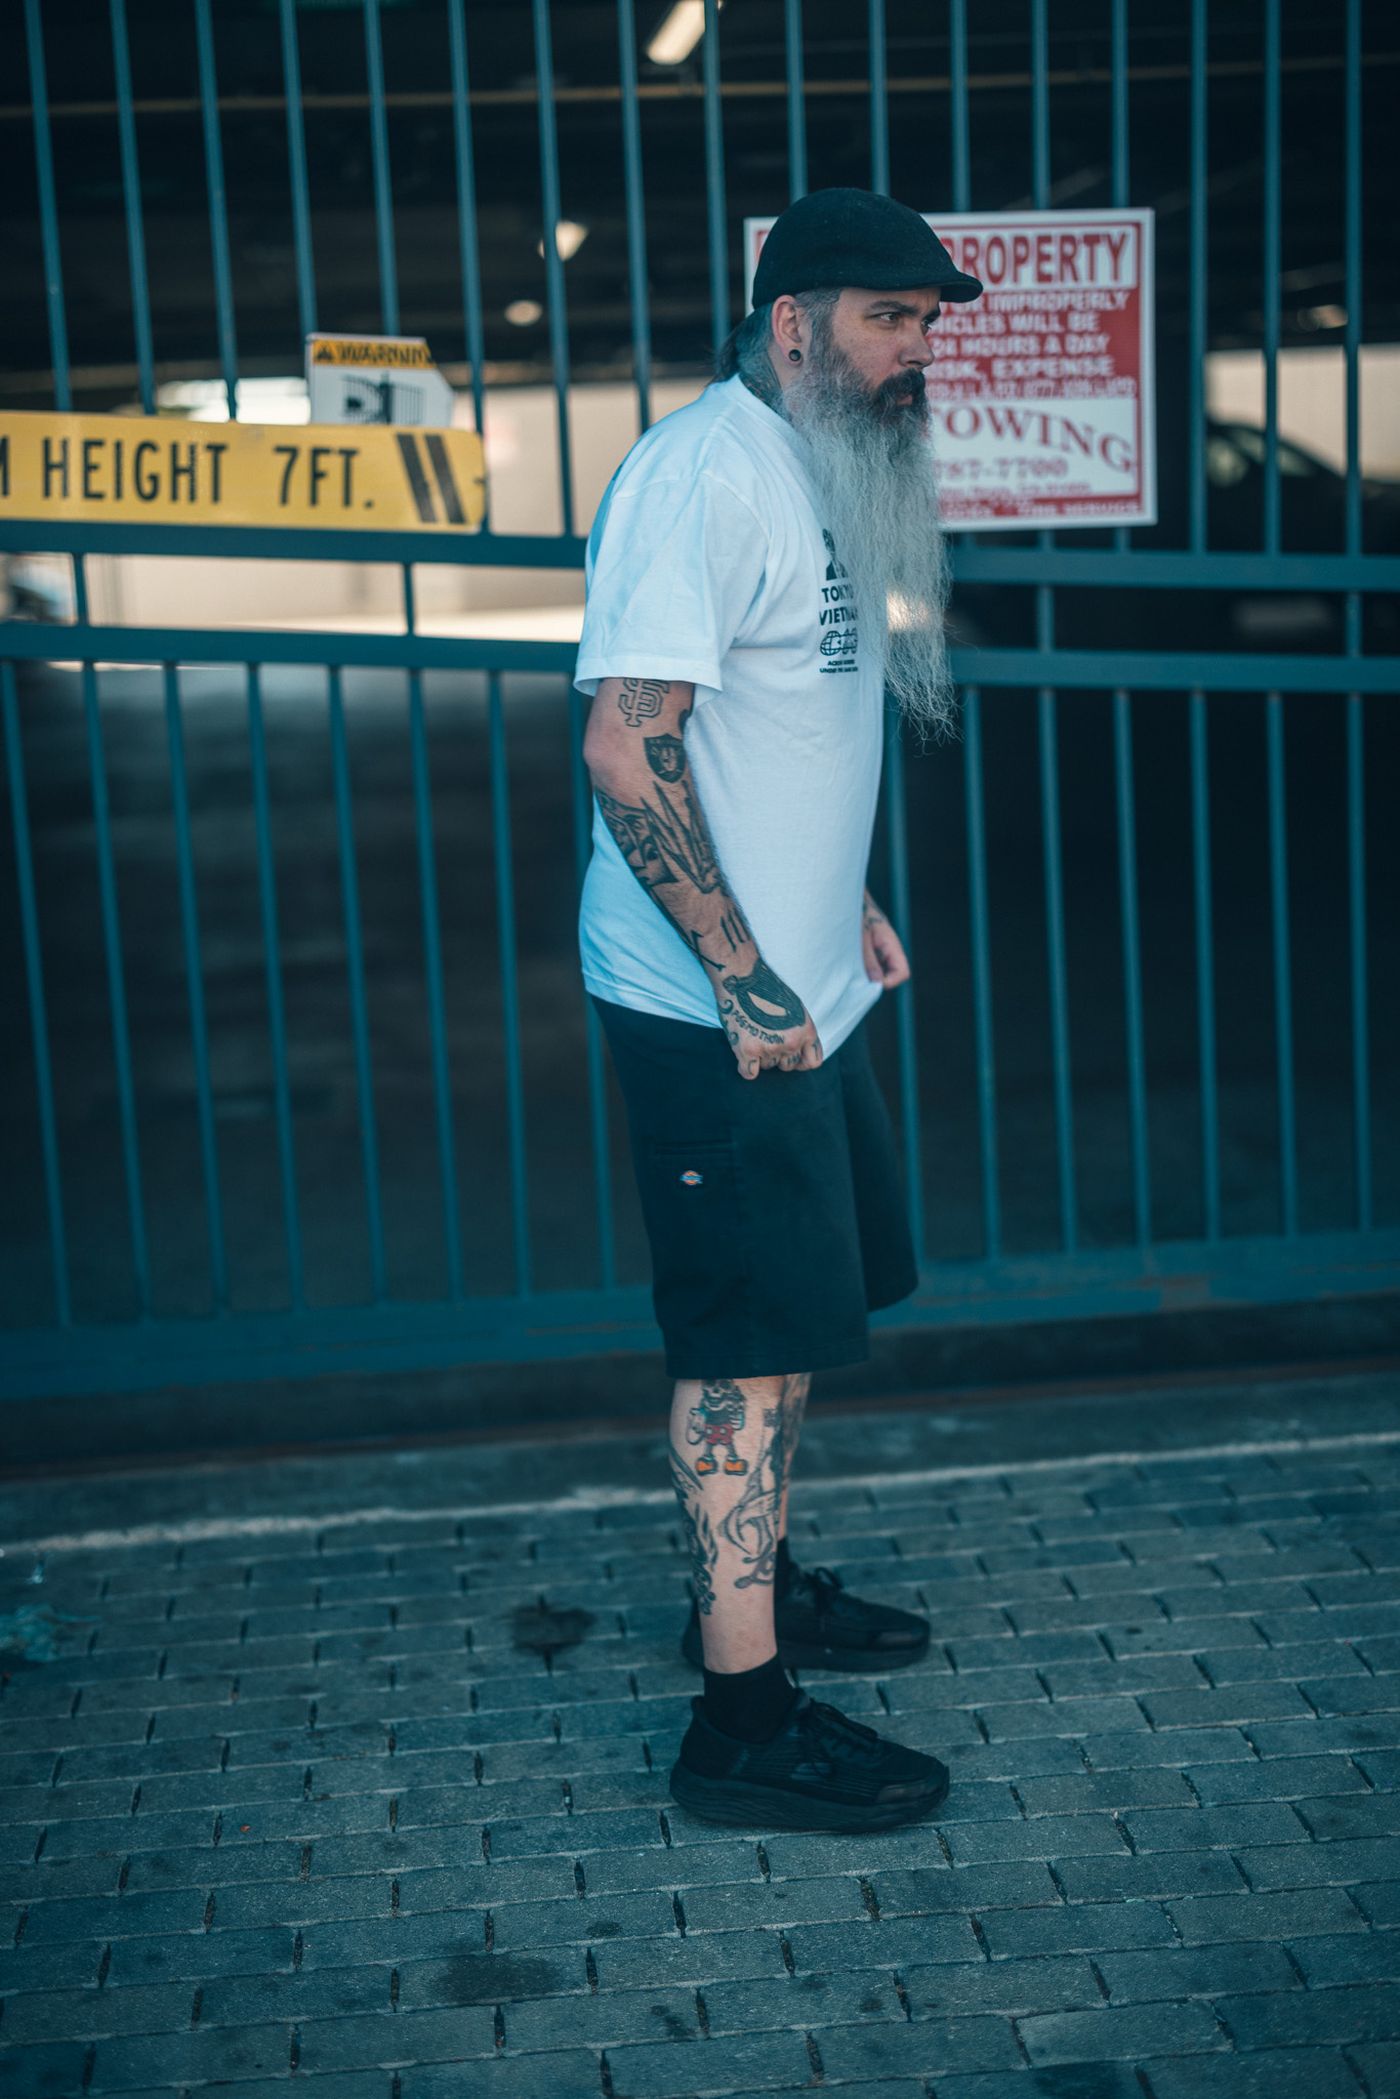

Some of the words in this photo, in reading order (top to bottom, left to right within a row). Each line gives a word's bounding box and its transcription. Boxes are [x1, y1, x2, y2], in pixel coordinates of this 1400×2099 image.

[1008, 312, 1065, 334] WILL
[959, 335, 1041, 357] HOURS
[1043, 334, 1063, 355] A
[990, 356, 1115, 380] EXPENSE
[43, 436, 228, 504] HEIGHT
[273, 445, 375, 509] 7FT.
